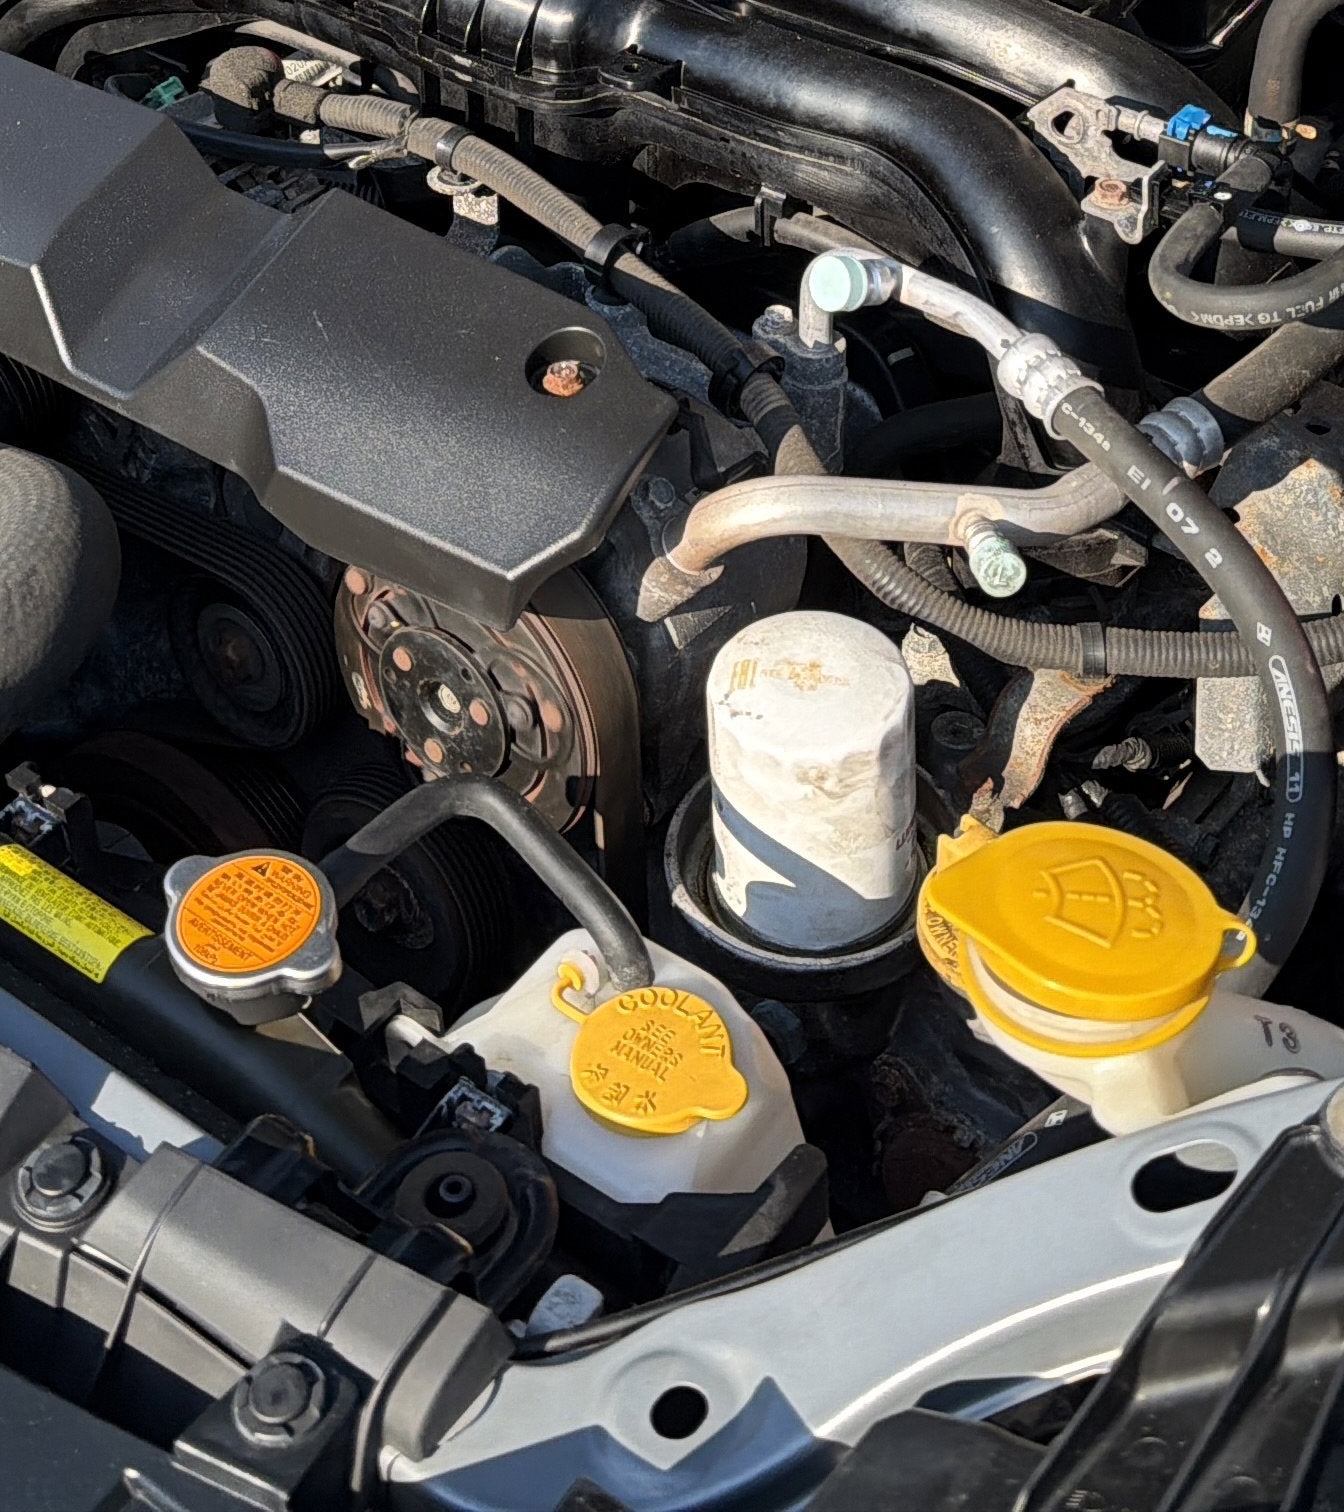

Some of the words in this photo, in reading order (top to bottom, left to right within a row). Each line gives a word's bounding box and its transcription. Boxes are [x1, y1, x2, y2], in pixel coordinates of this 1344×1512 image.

[1258, 314, 1282, 326] TG
[1286, 300, 1325, 320] FUEL
[1060, 402, 1111, 452] C-134a
[1166, 502, 1200, 536] 07
[1204, 547, 1223, 570] 2
[1288, 772, 1301, 793] 11
[1283, 812, 1296, 838] HP
[618, 988, 726, 1059] COOLANT
[640, 1019, 676, 1041] SEE
[622, 1028, 684, 1067] OWNERS
[610, 1040, 671, 1083] MANUAL
